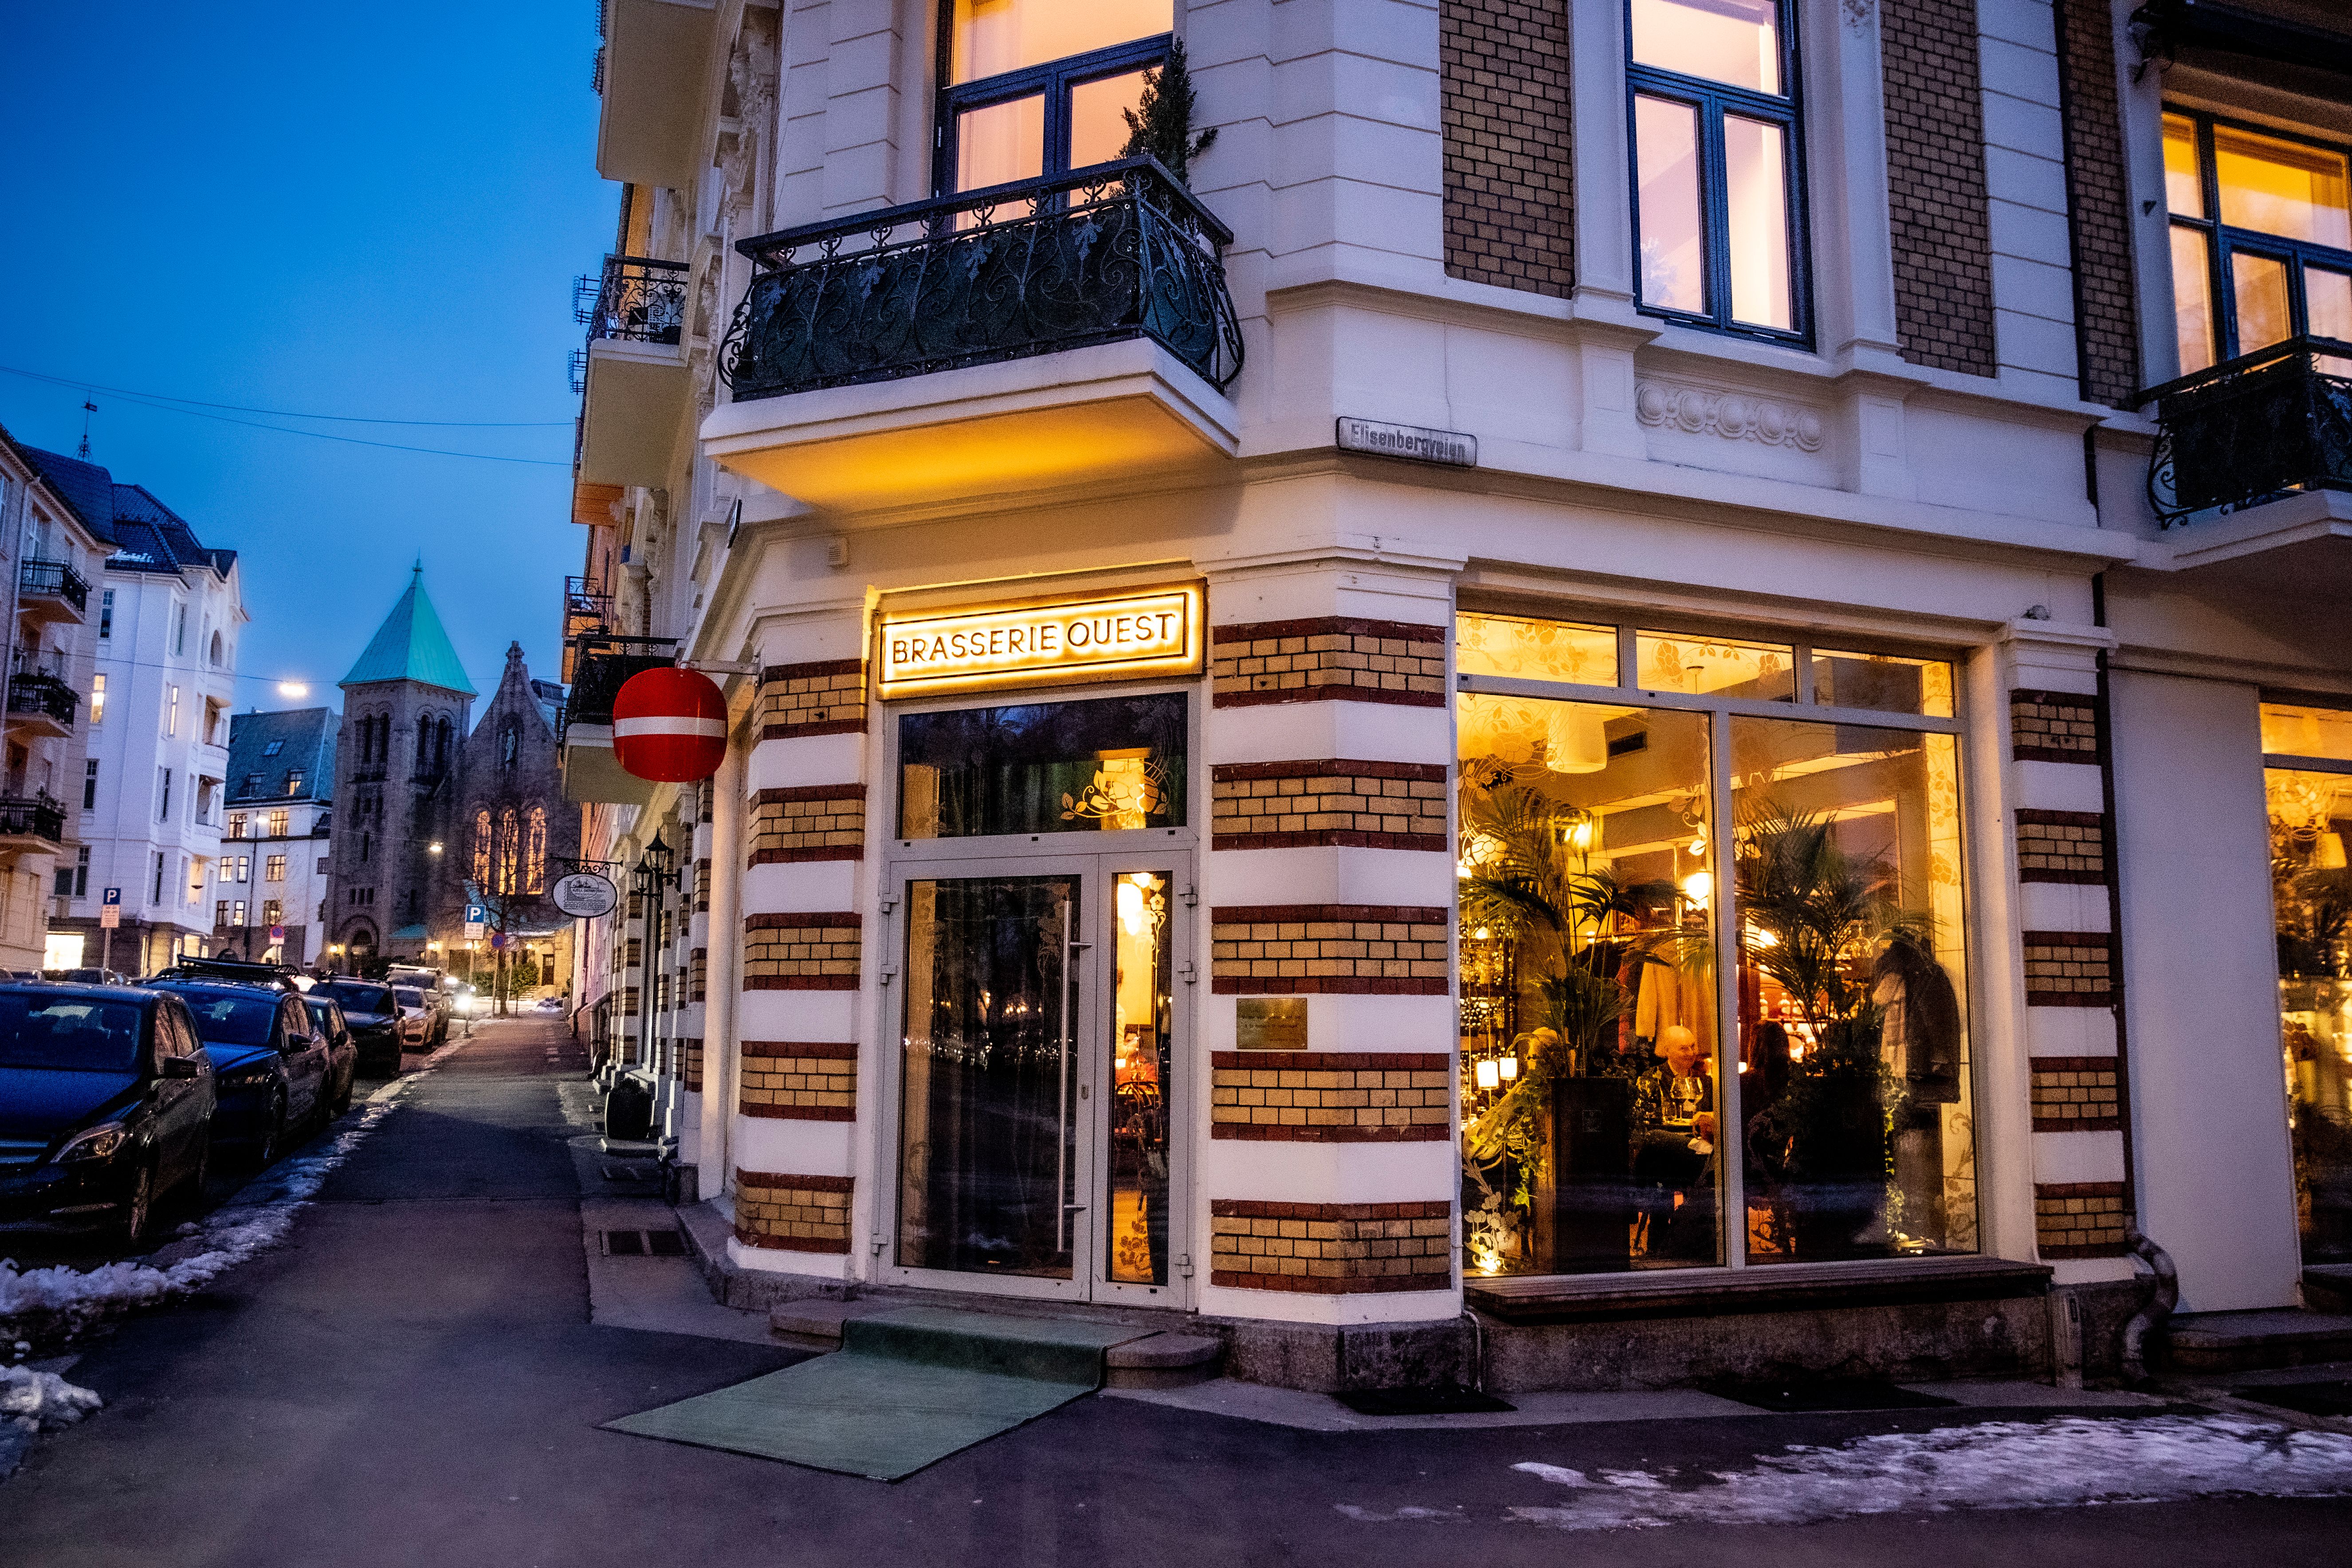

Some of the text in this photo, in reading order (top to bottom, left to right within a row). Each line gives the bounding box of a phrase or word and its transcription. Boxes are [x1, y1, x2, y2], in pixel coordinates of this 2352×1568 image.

[1351, 423, 1465, 457] Elisenbergveien
[892, 613, 1175, 664] BRASSERIE OUEST
[106, 889, 117, 903] P
[470, 907, 481, 921] P
